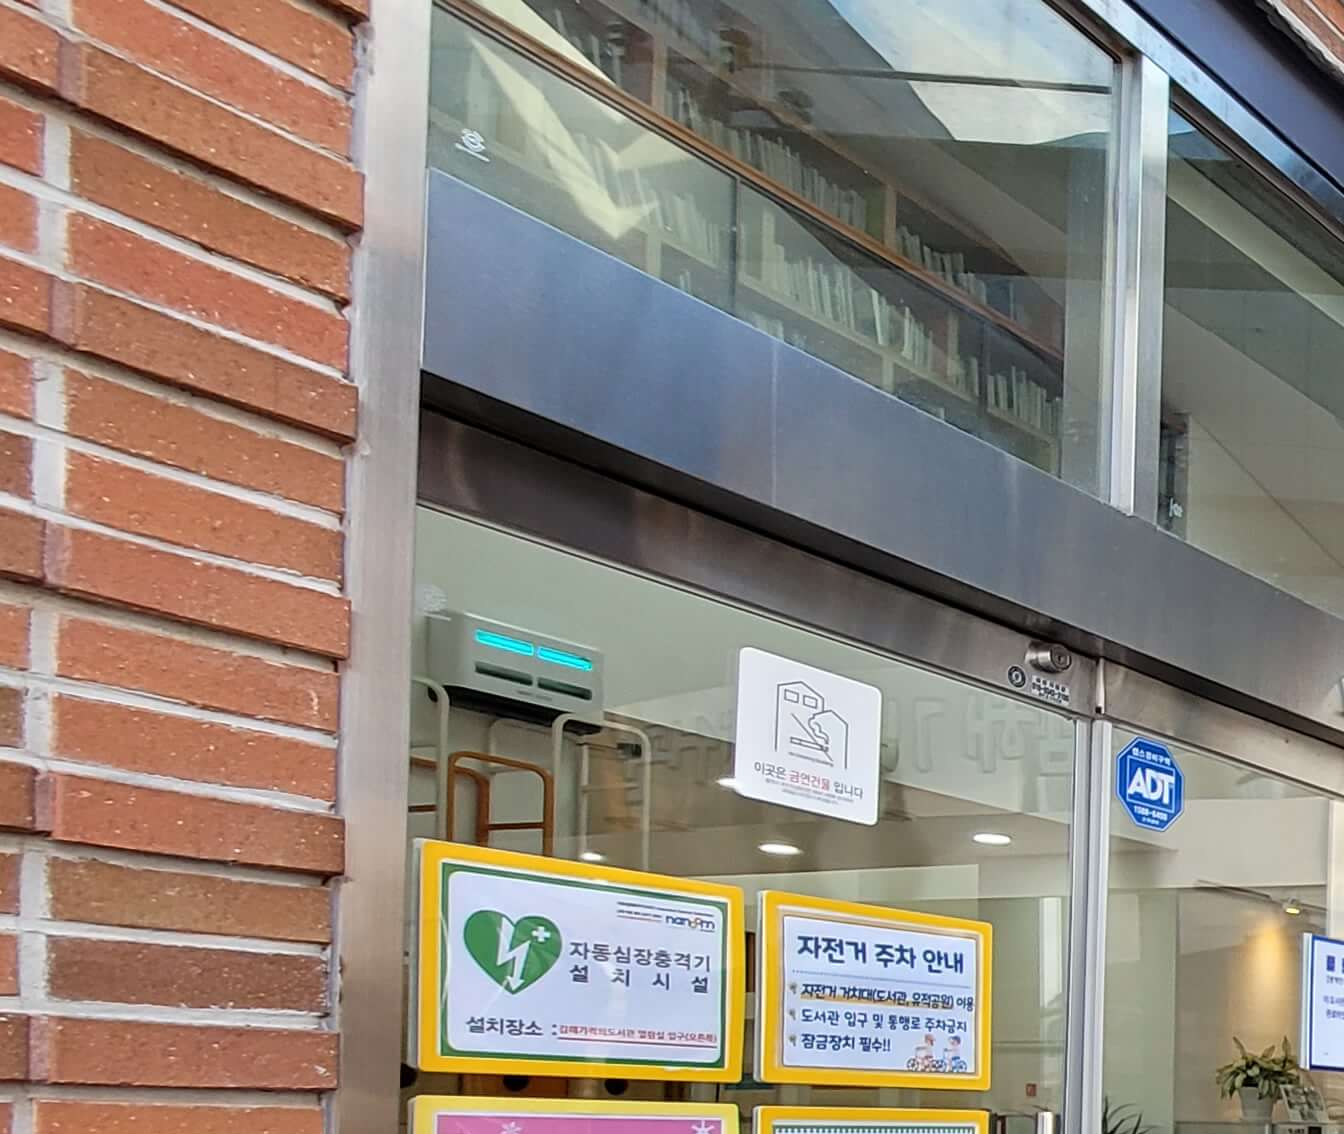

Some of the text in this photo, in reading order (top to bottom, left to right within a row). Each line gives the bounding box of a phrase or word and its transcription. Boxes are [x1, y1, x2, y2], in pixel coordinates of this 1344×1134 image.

[754, 761, 787, 781] 이곳은
[789, 769, 831, 790] 금연건물
[833, 781, 864, 799] 입니다
[1128, 767, 1176, 805] ADT
[569, 941, 711, 973] 자동심장충격기
[797, 934, 965, 974] 자전거 주차 안내
[801, 983, 838, 999] 자전거
[956, 997, 975, 1013] 이용
[466, 1014, 544, 1037] 설치장소
[801, 1008, 840, 1026] 도서관
[844, 1010, 869, 1028] 입구
[872, 1013, 884, 1029] 및
[924, 1018, 968, 1034] 주차금지
[800, 1033, 892, 1053] 잠금장치 필수!!
